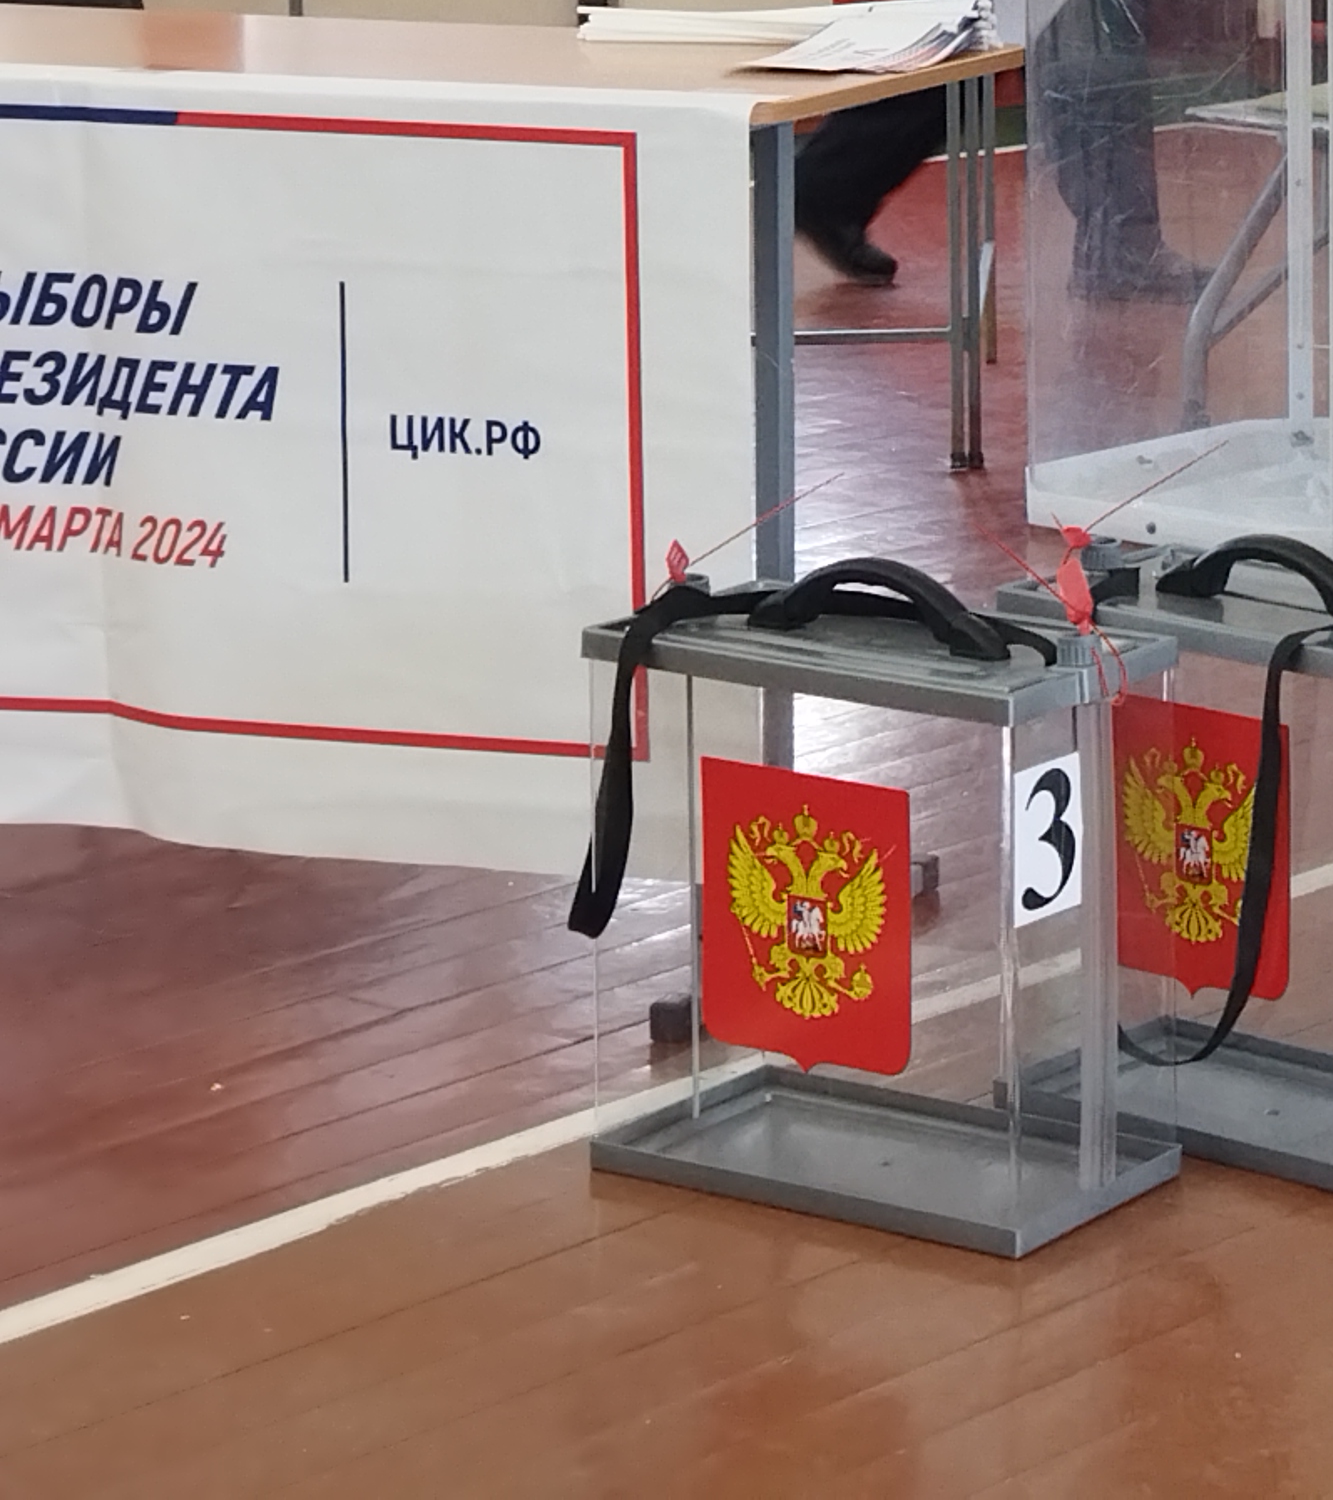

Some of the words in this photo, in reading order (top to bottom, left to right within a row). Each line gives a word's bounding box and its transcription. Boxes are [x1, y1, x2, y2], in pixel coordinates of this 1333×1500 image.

[0, 428, 122, 487] СИИ
[390, 413, 542, 460] ЦИК.РФ
[0, 503, 124, 558] МАРТА
[131, 514, 228, 569] 2024
[1021, 767, 1076, 911] 3
